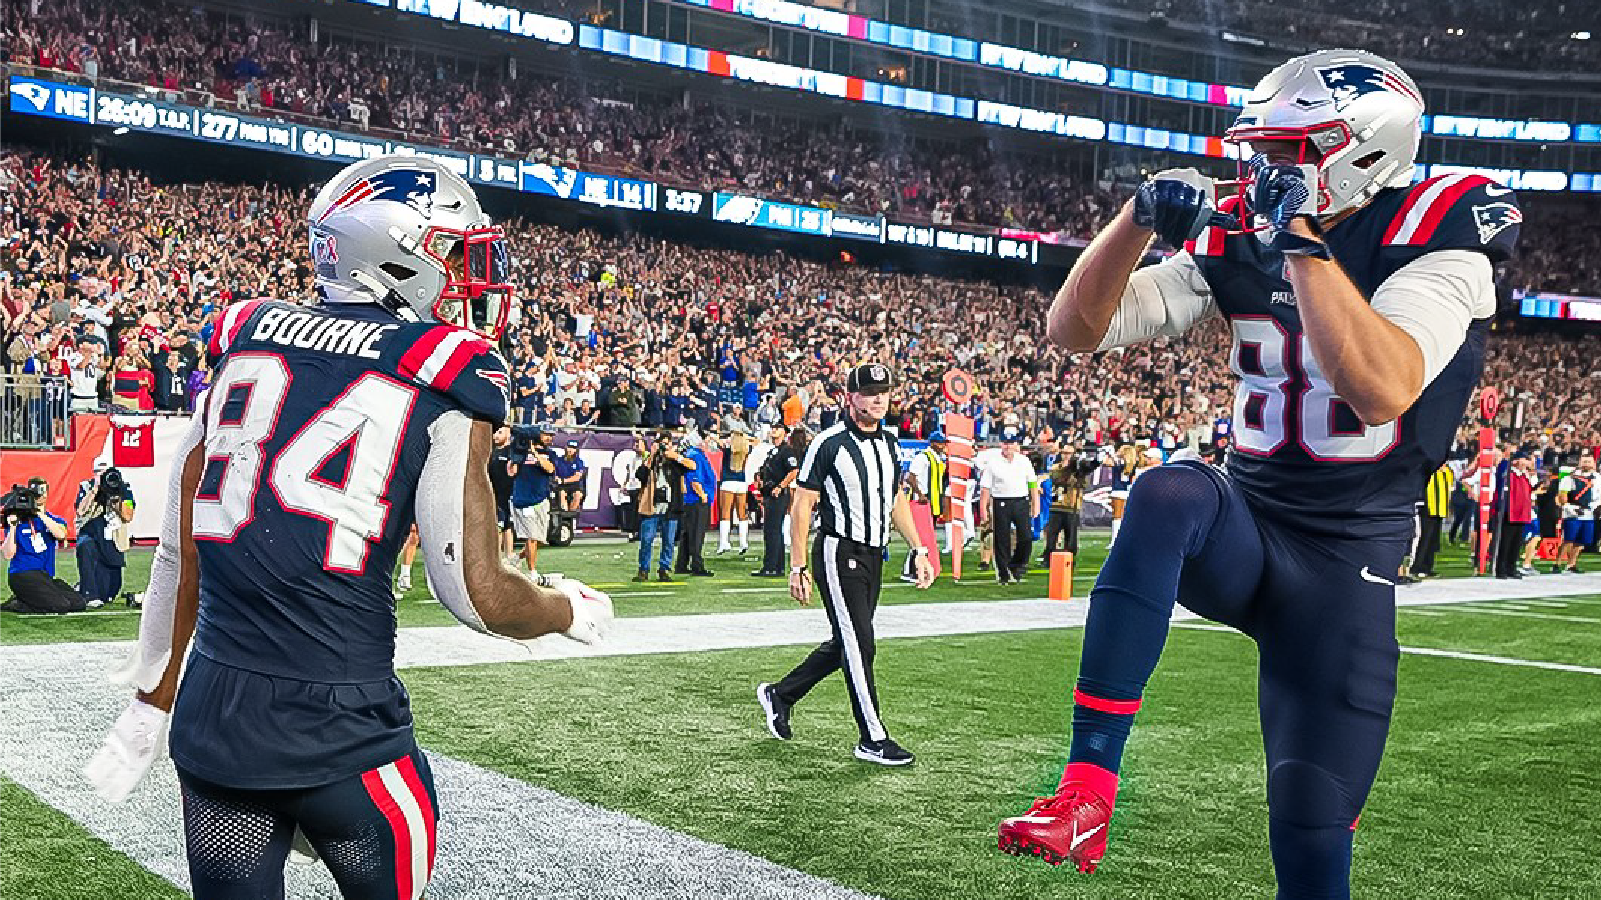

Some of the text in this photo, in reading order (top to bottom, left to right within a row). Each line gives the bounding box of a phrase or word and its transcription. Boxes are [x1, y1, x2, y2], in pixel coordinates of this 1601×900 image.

[55, 89, 88, 117] NE
[201, 112, 239, 140] 277
[302, 130, 334, 156] 60
[251, 308, 400, 359] BOURNE
[121, 429, 142, 447] 12
[192, 350, 420, 576] 84
